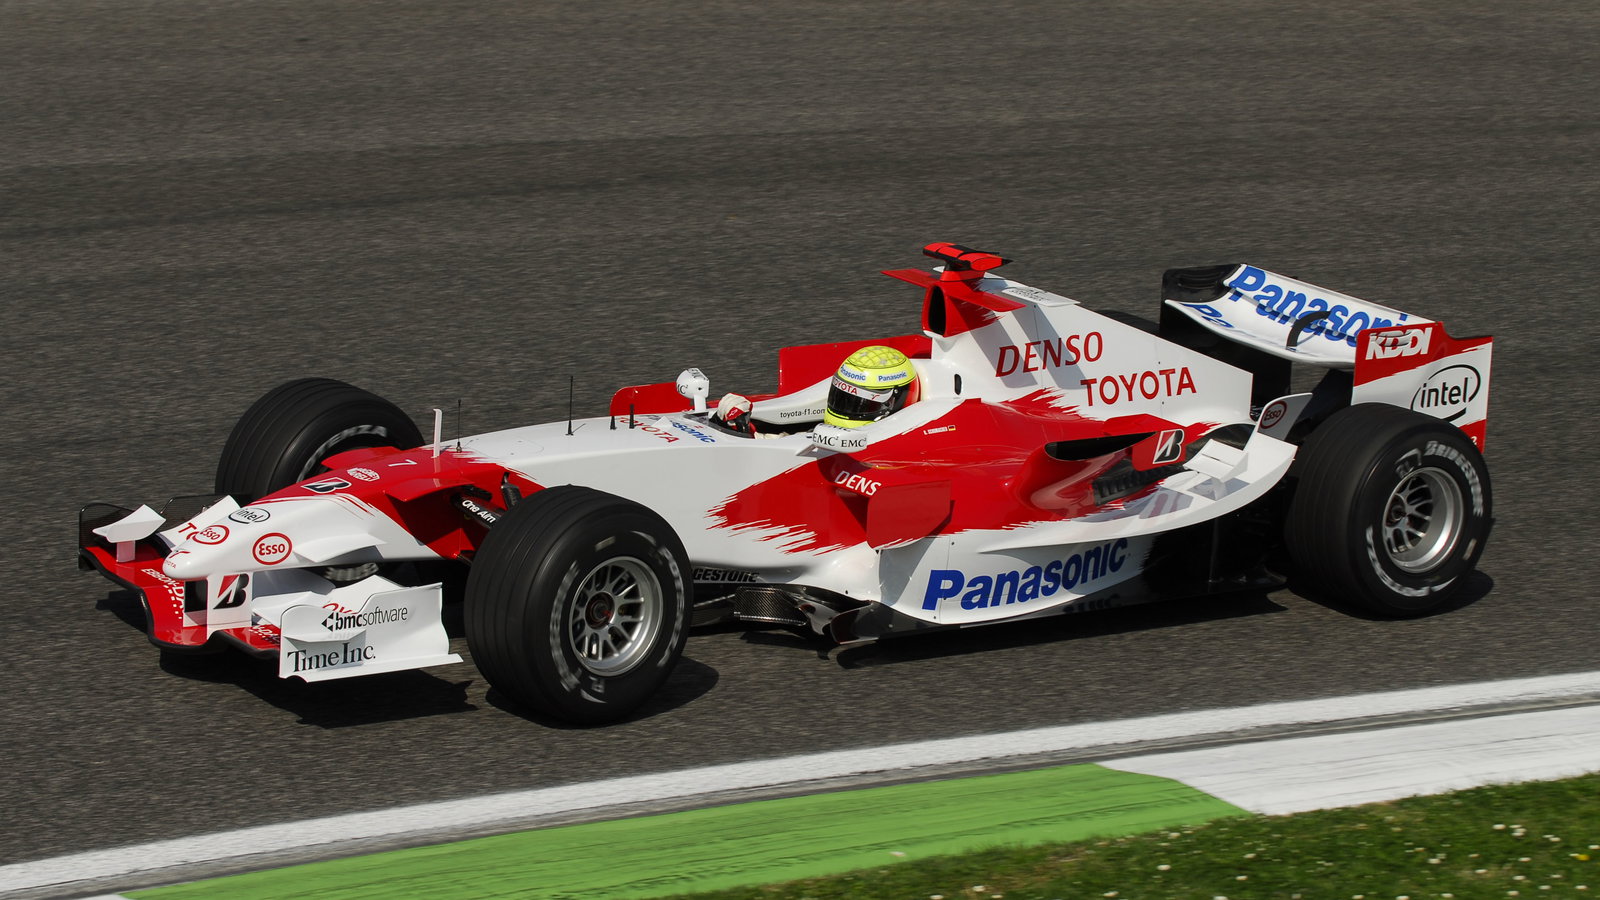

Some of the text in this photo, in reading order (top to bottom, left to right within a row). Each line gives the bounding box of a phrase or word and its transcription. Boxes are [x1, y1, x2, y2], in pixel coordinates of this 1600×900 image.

[1229, 265, 1408, 347] Panason
[995, 331, 1104, 377] DENSO
[1365, 327, 1433, 360] KDDI
[878, 372, 907, 382] Panasonic
[1081, 367, 1197, 406] TOYOTA
[1421, 377, 1468, 408] intel
[1263, 407, 1283, 422] Esso
[388, 459, 417, 467] 7
[834, 470, 882, 496] DENS
[235, 509, 265, 523] intel
[462, 499, 496, 523] One Aim
[200, 526, 221, 541] Esso
[258, 543, 286, 556] Esso
[693, 568, 760, 582] GESTONE
[922, 537, 1128, 611] Panasonic
